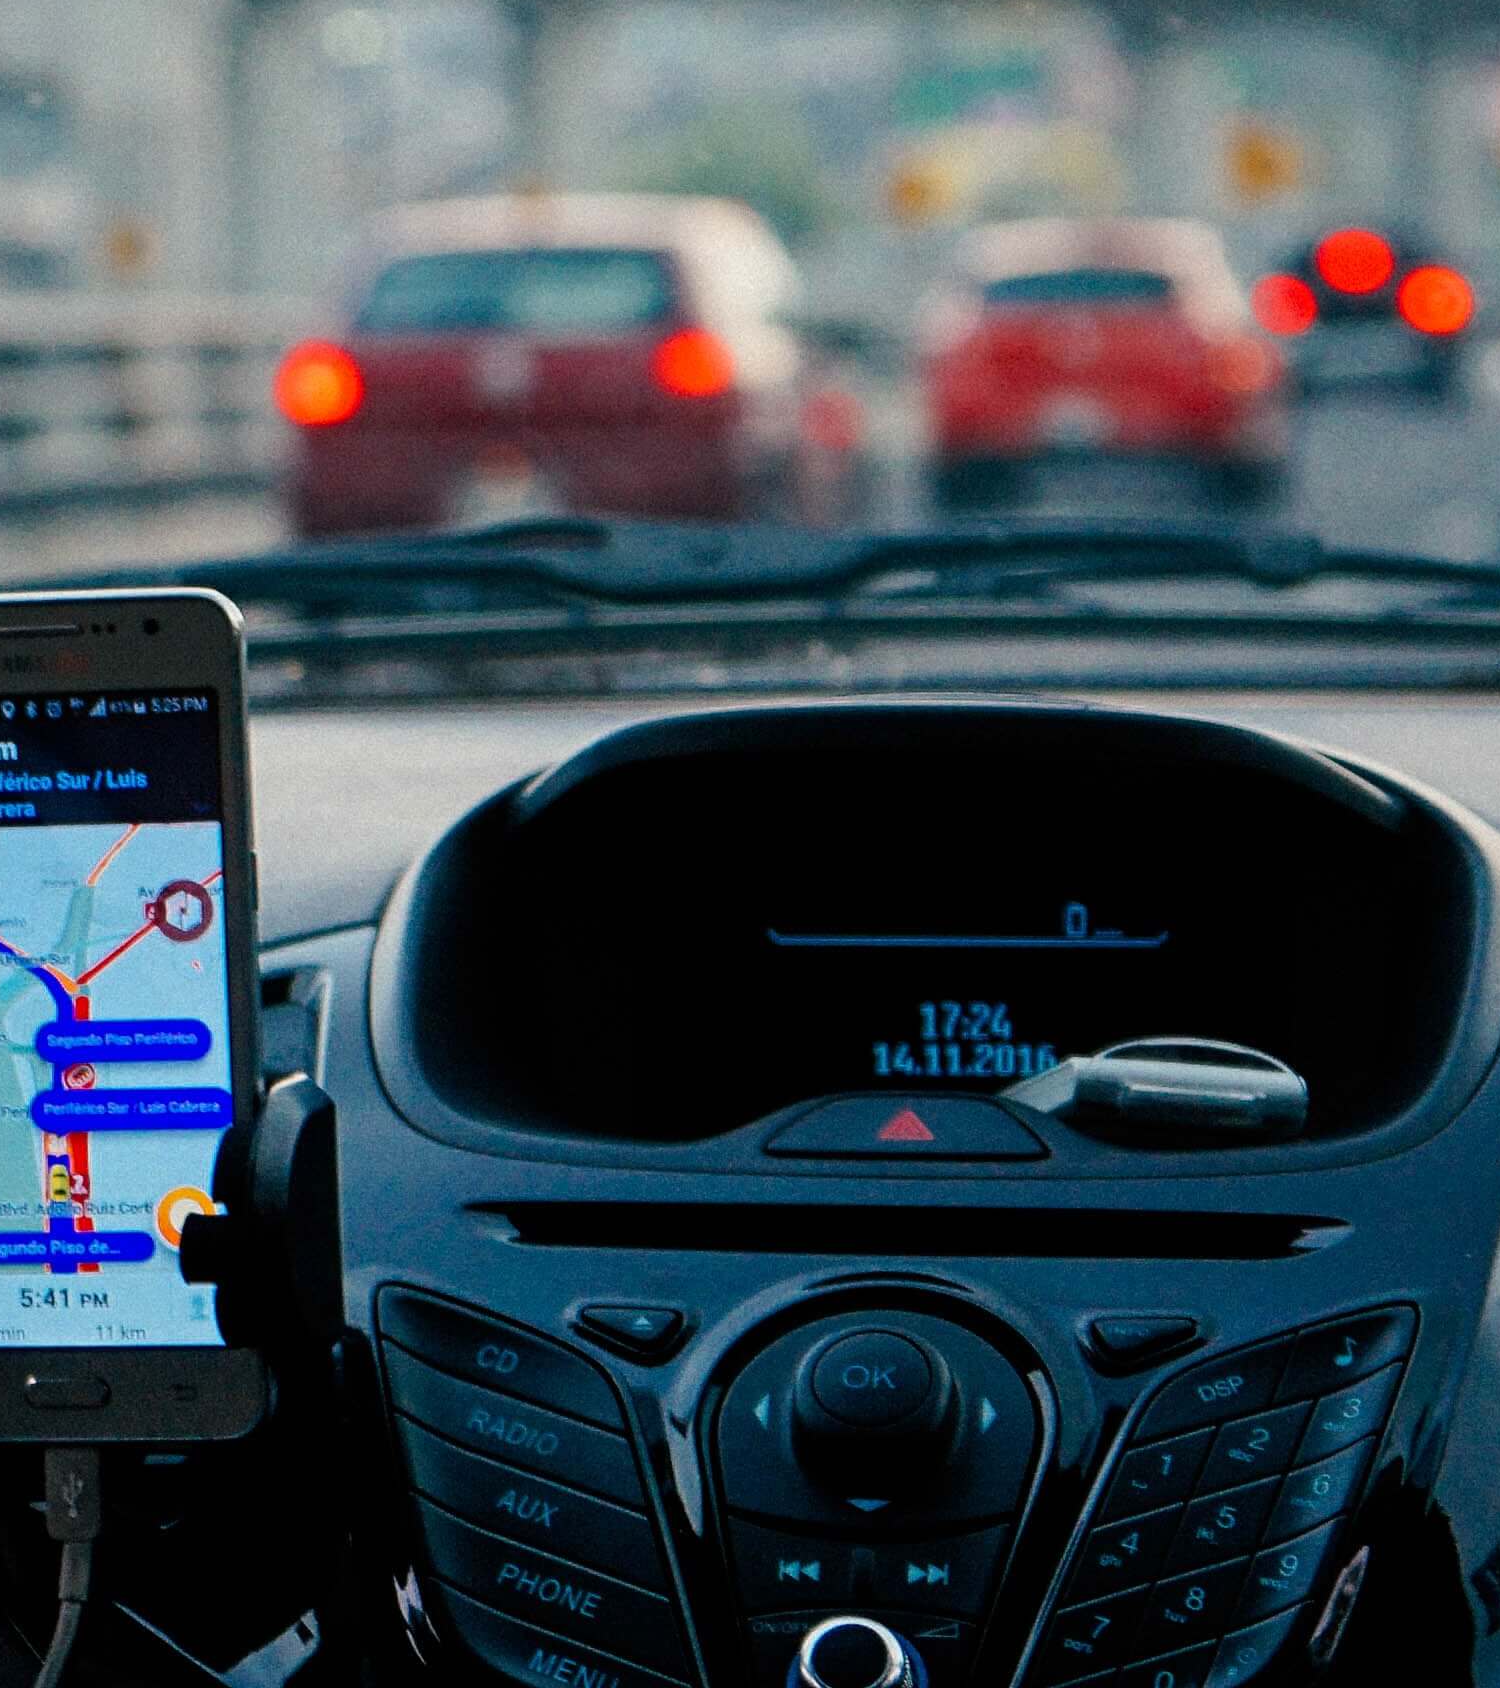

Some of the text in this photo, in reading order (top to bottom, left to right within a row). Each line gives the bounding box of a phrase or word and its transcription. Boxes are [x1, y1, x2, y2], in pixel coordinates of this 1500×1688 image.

[57, 771, 90, 791] Sur
[93, 771, 102, 790] /
[105, 768, 149, 789] Luis
[918, 1000, 1014, 1040] 17:24
[872, 1040, 1058, 1078] 14.11.2016
[51, 1240, 85, 1255] Piso
[20, 1288, 109, 1309] 5:41 PM
[96, 1326, 114, 1342] 11
[119, 1325, 146, 1341] km
[475, 1344, 520, 1374] CD
[842, 1363, 898, 1390] OK
[1197, 1375, 1244, 1402] DSP
[1343, 1398, 1362, 1418] 3
[467, 1407, 560, 1457] RADIO
[1249, 1428, 1270, 1451] 2
[1161, 1453, 1173, 1476] 1
[1313, 1473, 1330, 1495] 6
[496, 1489, 560, 1528] AUX
[1216, 1505, 1237, 1529] 5
[1121, 1531, 1140, 1555] 4
[1279, 1554, 1298, 1576] 9
[496, 1561, 603, 1618] PHONE
[1185, 1586, 1206, 1611] 8
[1092, 1615, 1112, 1639] 7
